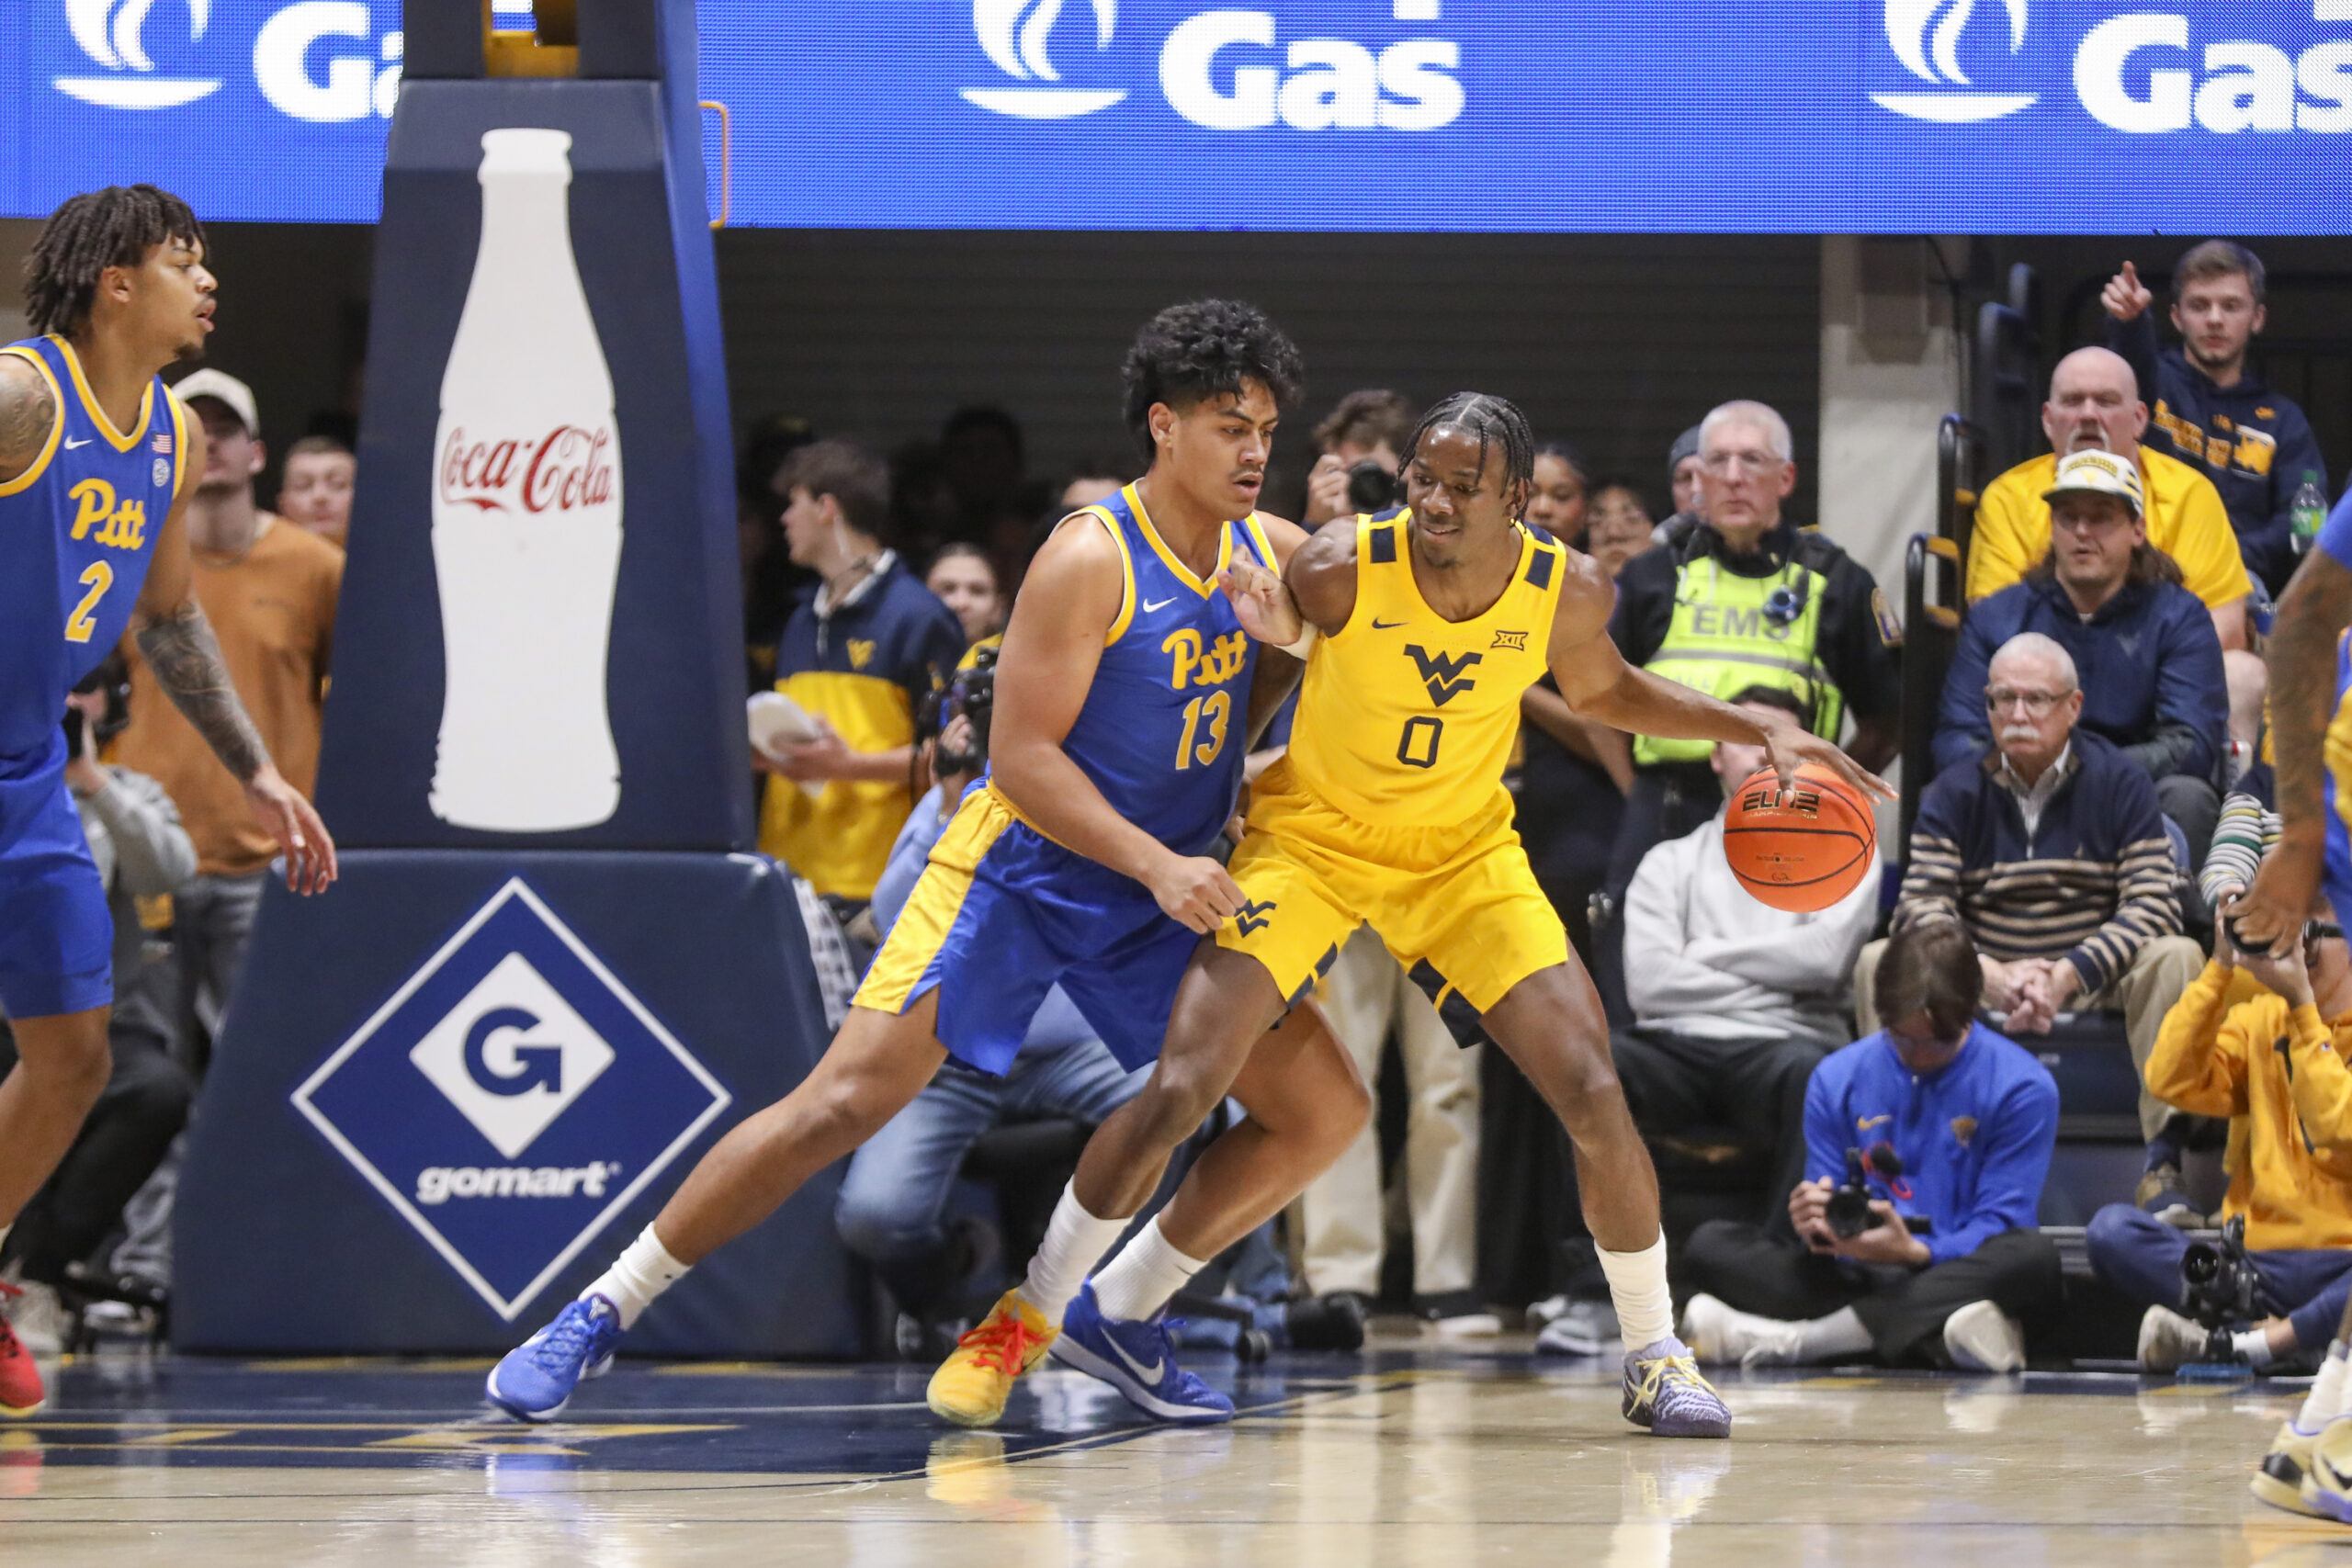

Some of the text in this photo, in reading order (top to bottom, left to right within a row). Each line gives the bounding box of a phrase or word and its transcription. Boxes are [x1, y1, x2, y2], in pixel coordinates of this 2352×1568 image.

[1159, 8, 1466, 131] Gas
[440, 424, 614, 513] Coca-Cola
[68, 477, 146, 550] Pitt
[63, 559, 115, 644] 2
[1161, 627, 1248, 690] Pitt
[1175, 689, 1231, 771] 13
[1396, 715, 1444, 769] 0
[464, 1008, 562, 1097] G
